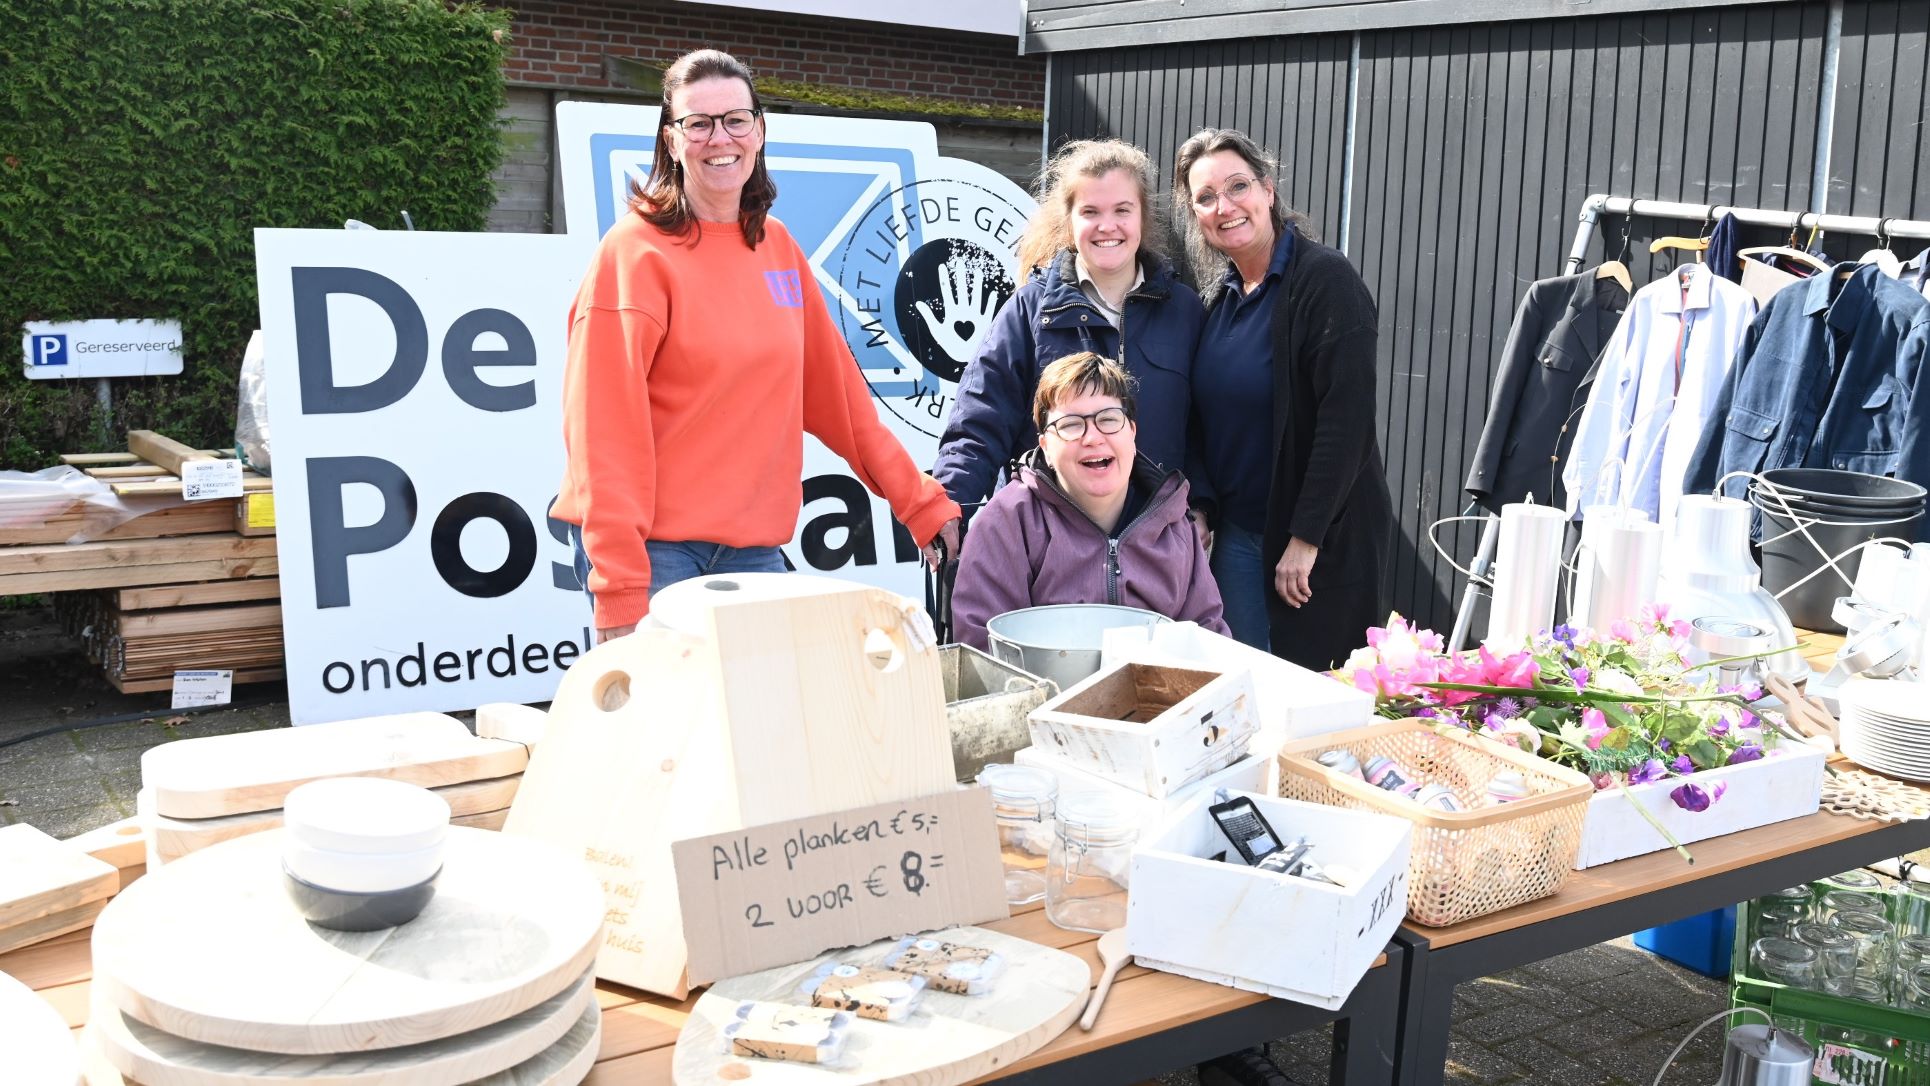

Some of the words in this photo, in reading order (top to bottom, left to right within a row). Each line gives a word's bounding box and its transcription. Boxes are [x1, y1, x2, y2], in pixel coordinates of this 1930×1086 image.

[866, 197, 961, 264] LIEFDE
[974, 206, 1023, 250] GE
[291, 266, 537, 415] De
[857, 271, 889, 348] MET
[75, 339, 176, 354] Gereserveerd
[905, 378, 956, 419] RK
[322, 626, 592, 694] onderdeel
[712, 836, 769, 881] Alle
[783, 819, 888, 871] planken
[745, 903, 775, 928] 2
